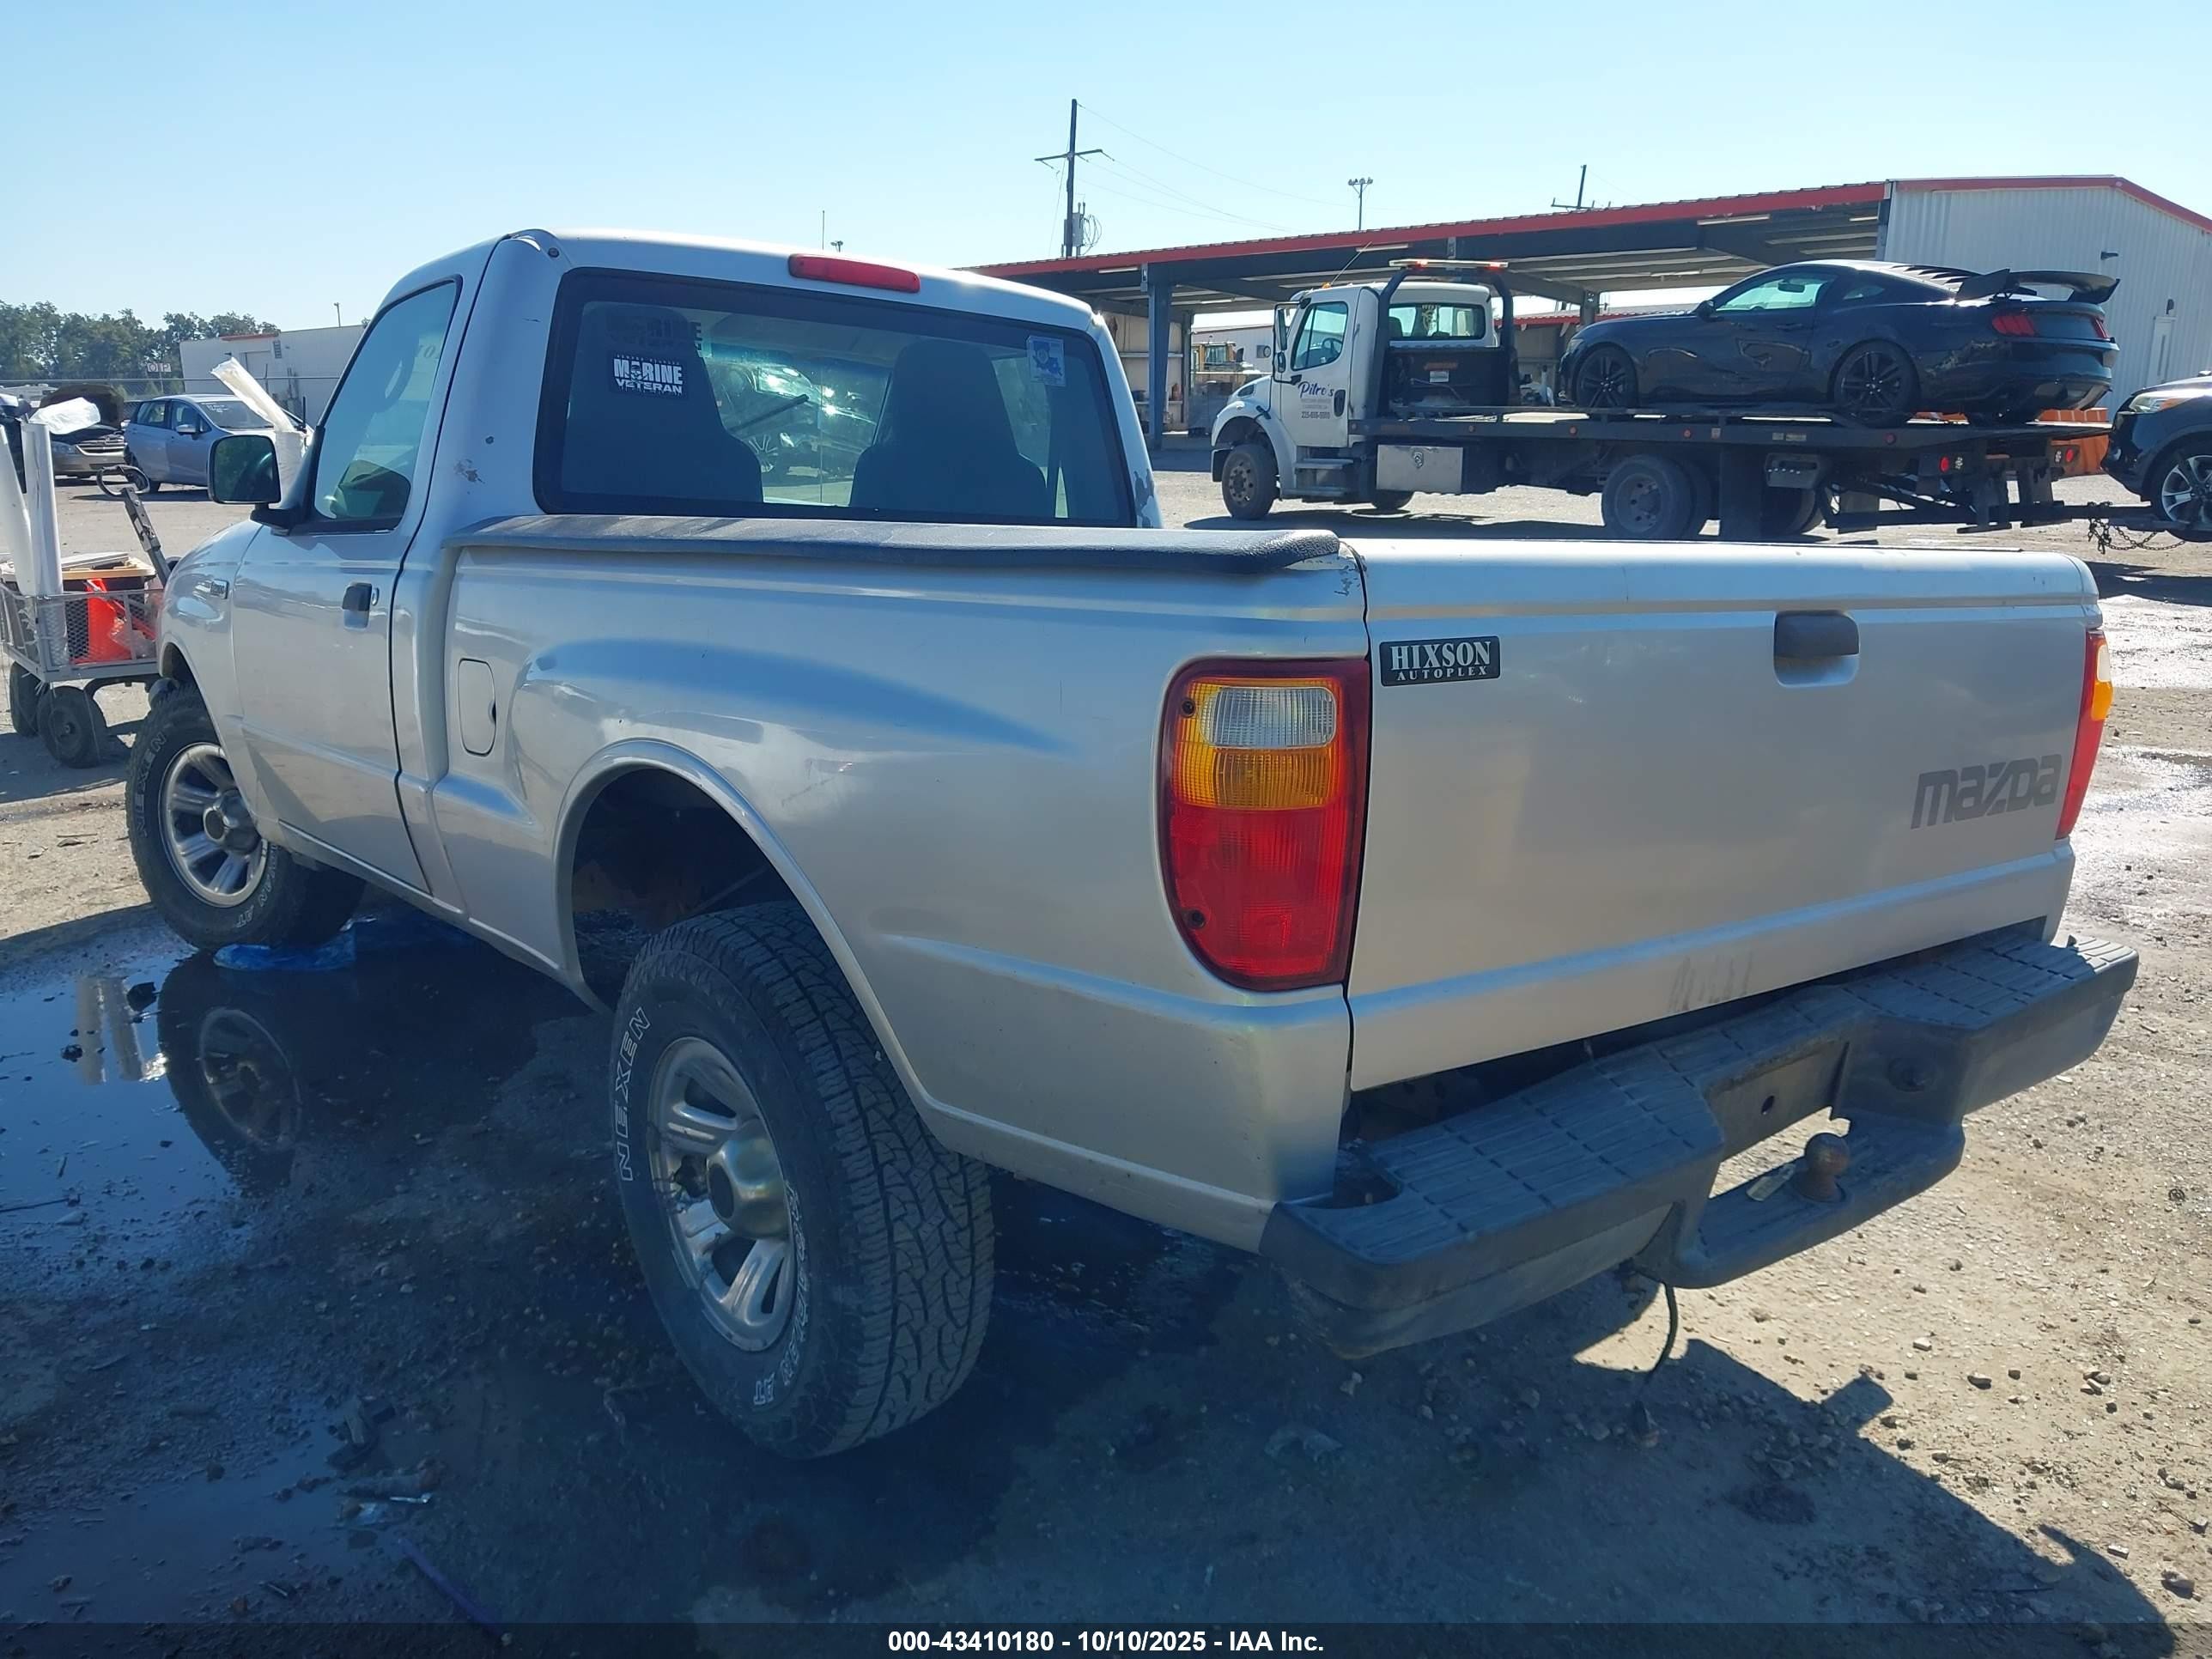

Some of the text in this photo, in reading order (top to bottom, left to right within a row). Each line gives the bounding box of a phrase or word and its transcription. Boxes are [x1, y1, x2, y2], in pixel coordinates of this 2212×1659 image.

[616, 378, 683, 394] VETERAN
[1390, 641, 1491, 670] HIXSON
[1397, 665, 1487, 681] AUTOPLEX
[615, 1006, 651, 1182] NEXEN
